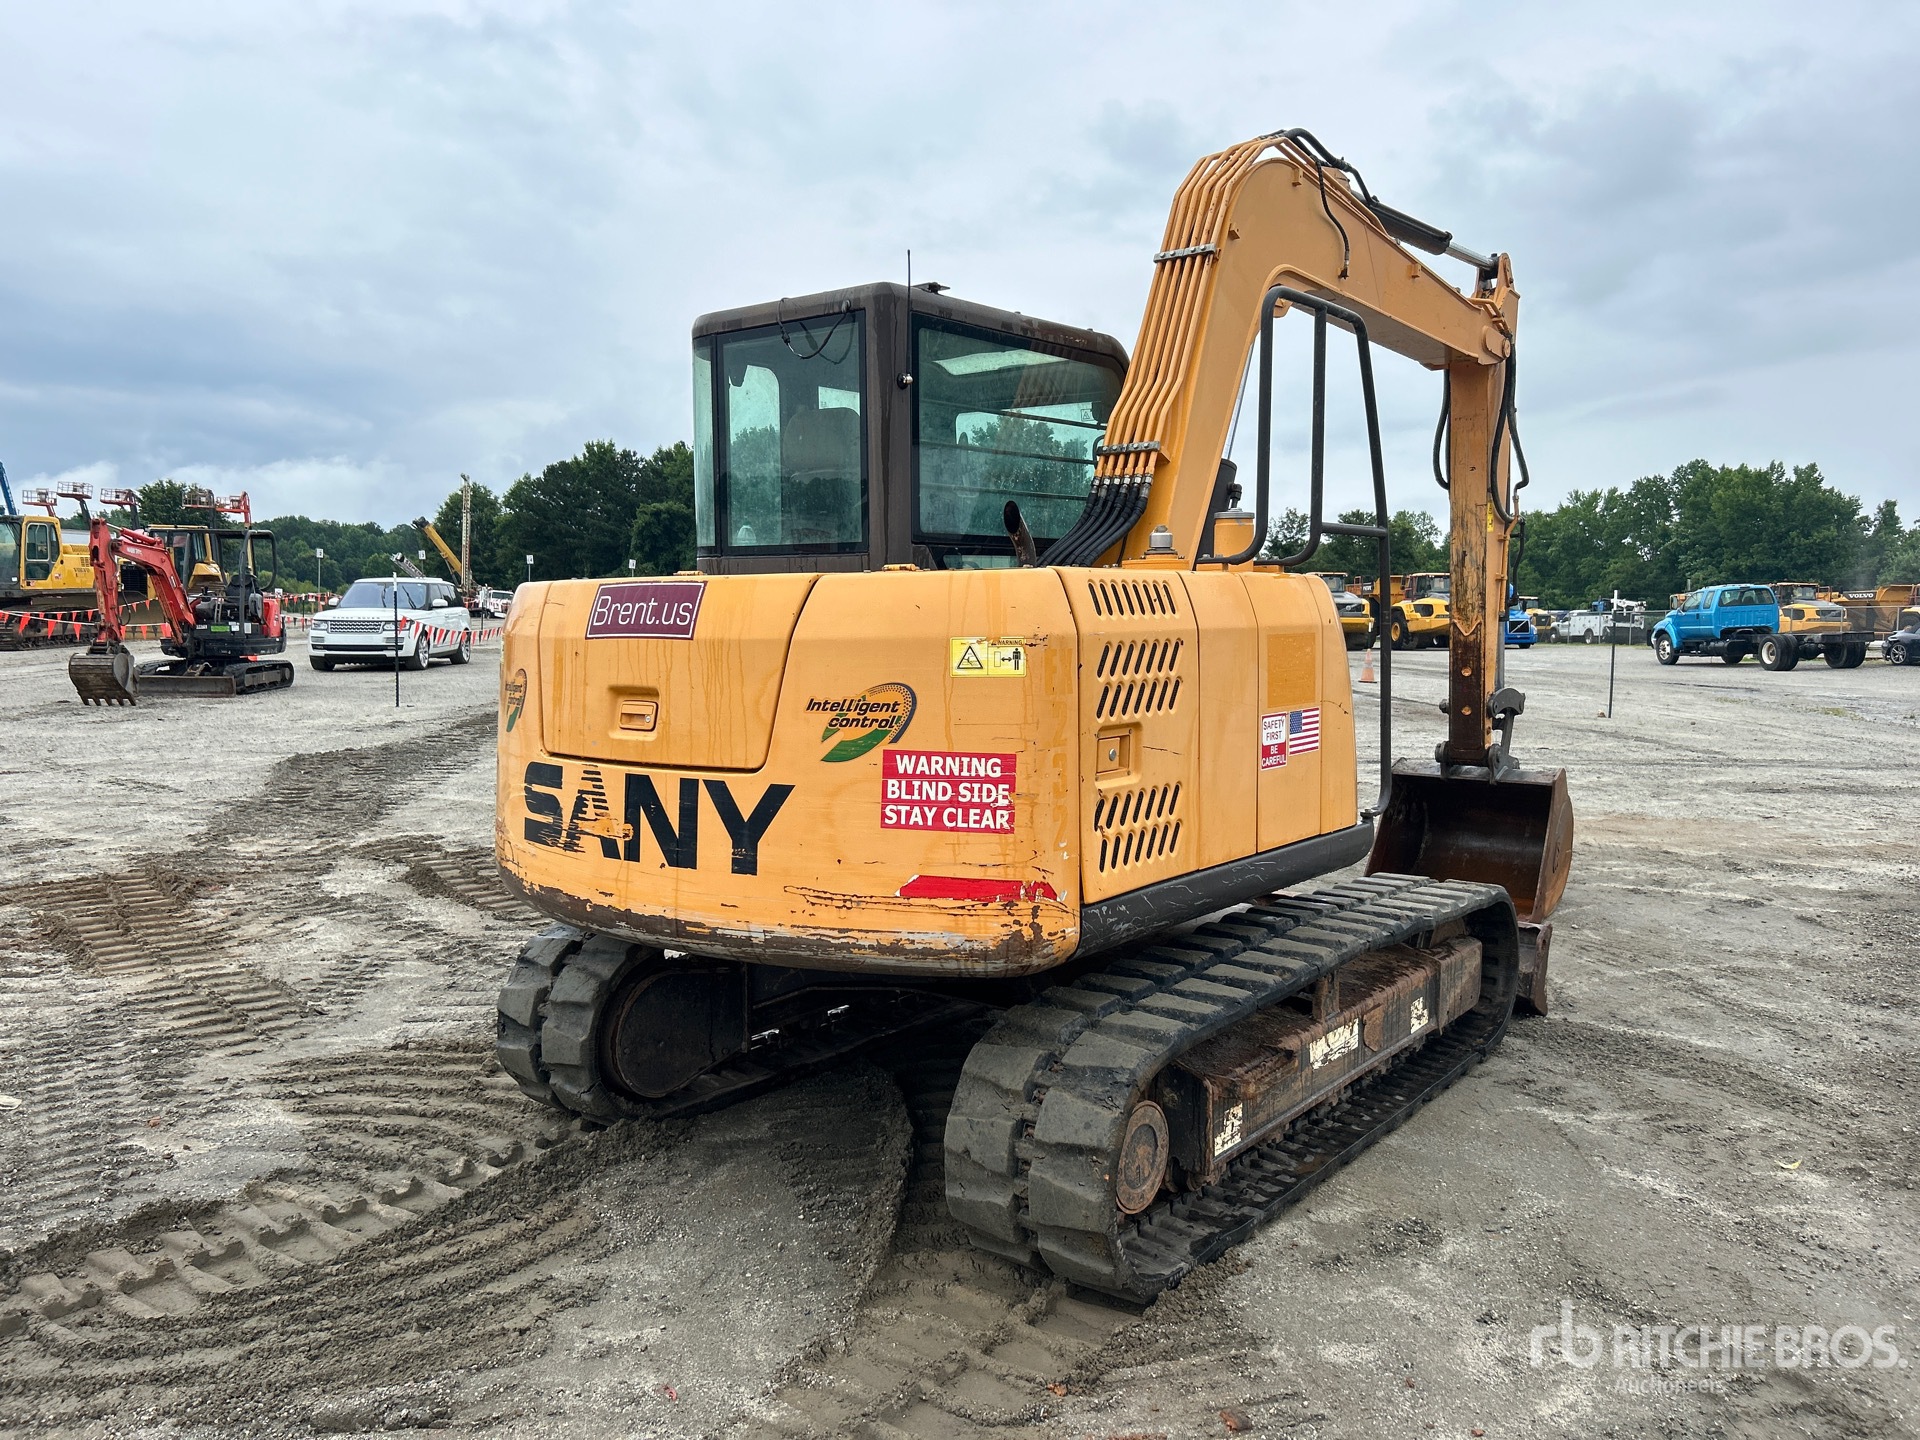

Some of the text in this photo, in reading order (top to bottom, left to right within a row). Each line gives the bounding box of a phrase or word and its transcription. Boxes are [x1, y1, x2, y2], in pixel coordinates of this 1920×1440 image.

[593, 596, 693, 626] Brent.us
[806, 698, 901, 716] Intelligent
[828, 713, 898, 729] control
[1263, 719, 1284, 730] SAFETY
[1266, 730, 1282, 741] FIRST
[1270, 745, 1278, 754] BE
[896, 754, 1002, 778] WARNING
[1261, 755, 1286, 767] CAREFUL
[886, 779, 1010, 805] BLIND SIDE
[524, 760, 796, 876] SANY
[884, 805, 1012, 829] STAY CLEAR
